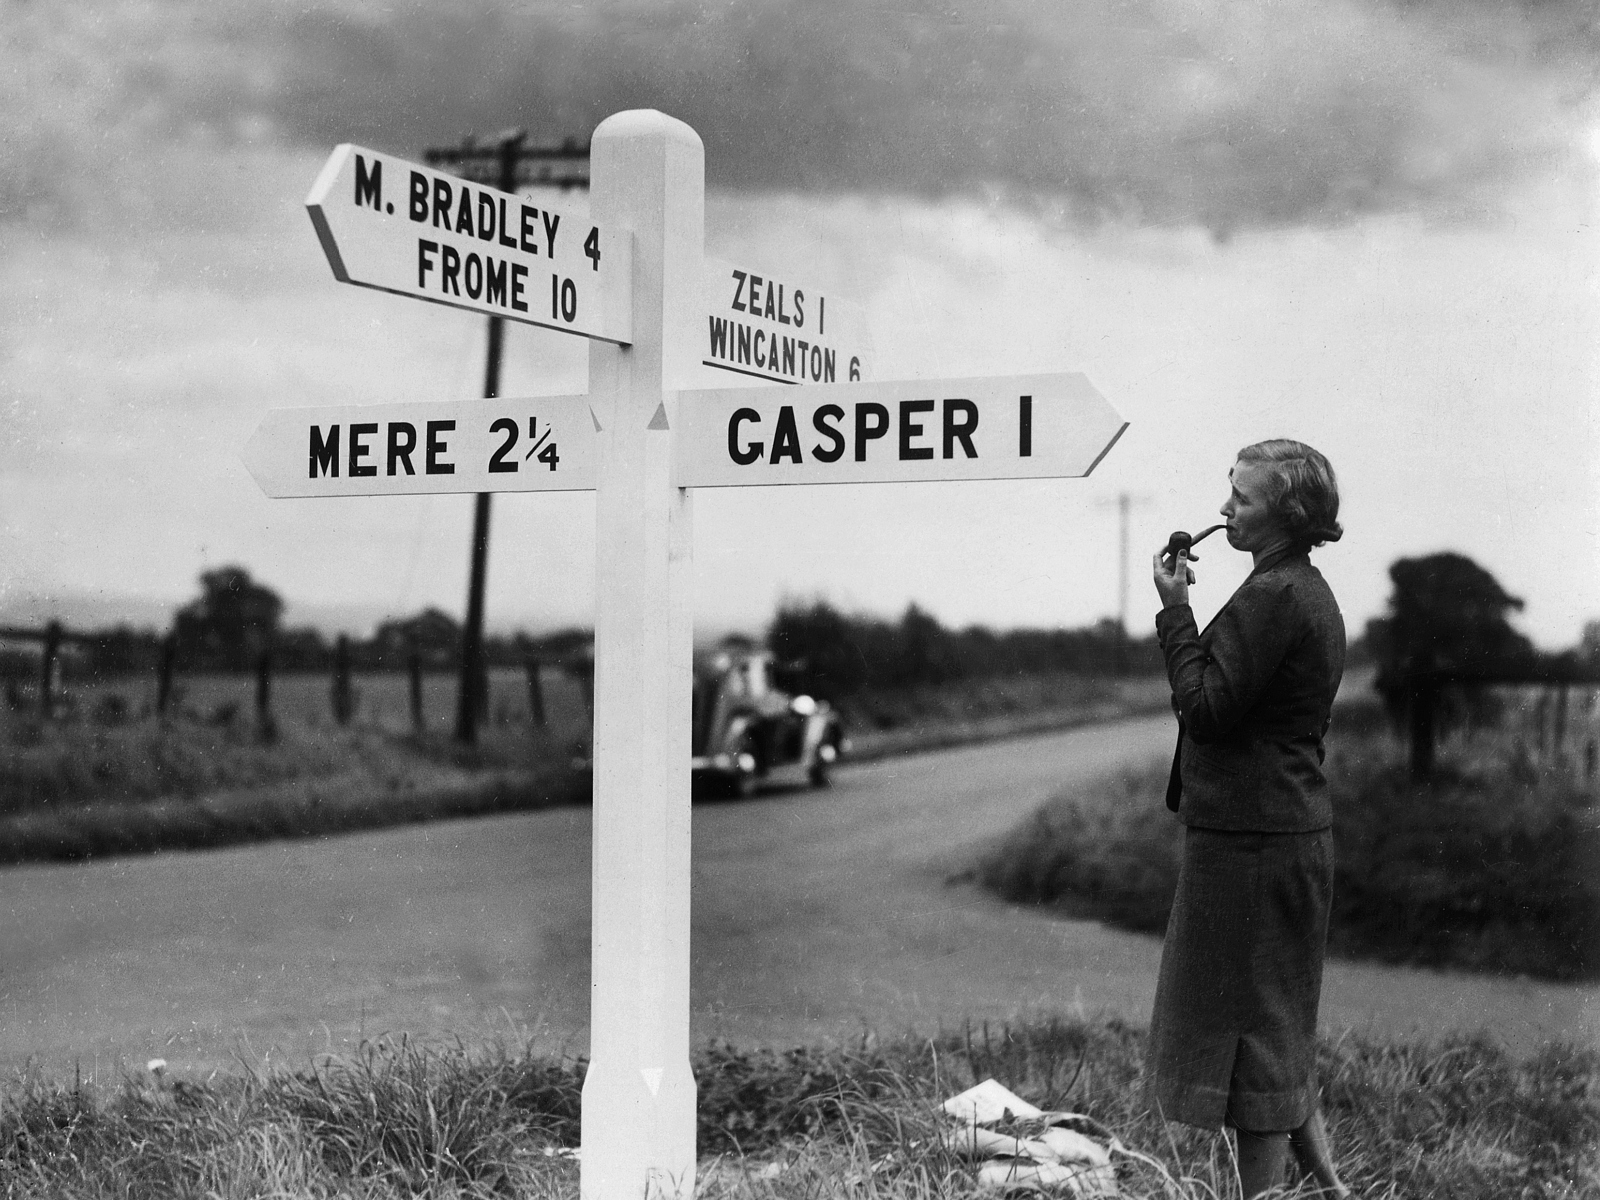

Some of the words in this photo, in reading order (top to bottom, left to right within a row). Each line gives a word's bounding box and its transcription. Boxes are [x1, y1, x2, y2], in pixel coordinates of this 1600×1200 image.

[354, 153, 395, 216] M.
[409, 169, 561, 260] BRADLEY
[583, 225, 602, 272] 4
[418, 237, 529, 313] FROME
[551, 272, 578, 323] 10
[731, 269, 805, 328] ZEALS
[818, 296, 825, 335] 1
[708, 314, 836, 383] WINCANTON
[308, 419, 457, 479] MERE
[727, 397, 979, 466] GASPER
[1019, 395, 1033, 457] 1
